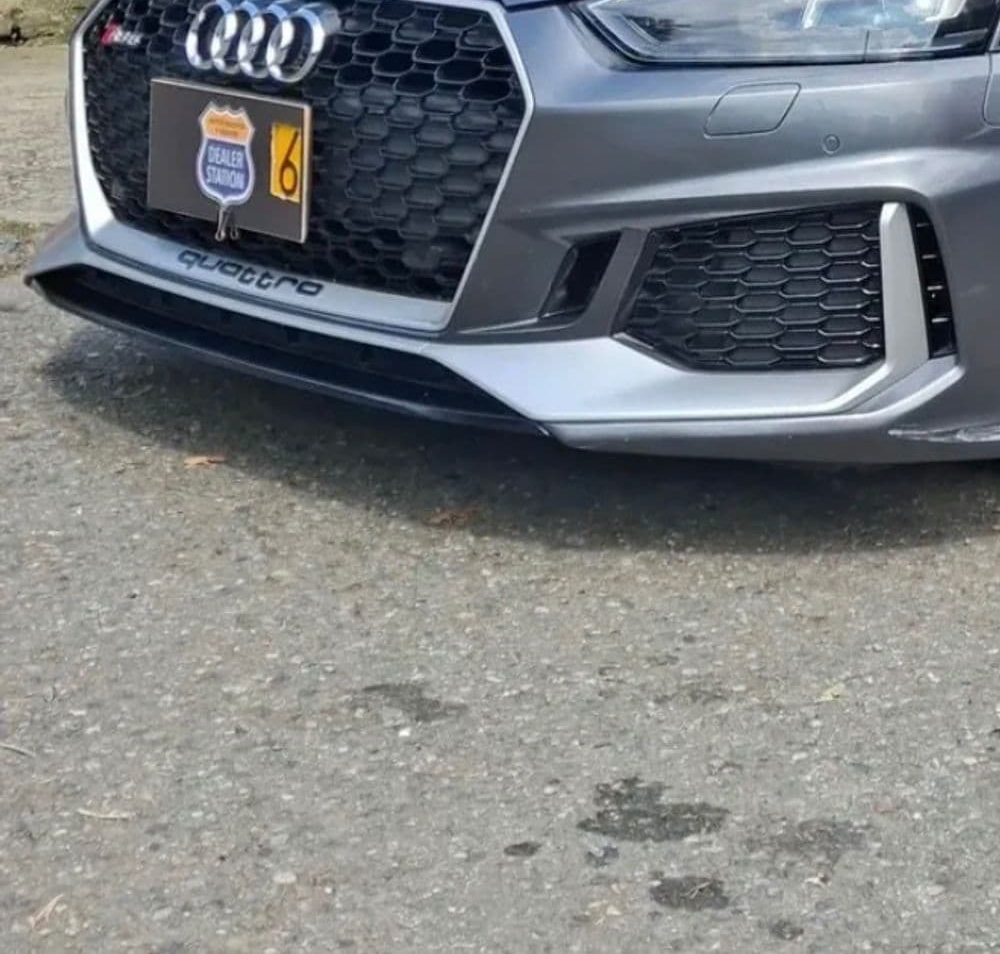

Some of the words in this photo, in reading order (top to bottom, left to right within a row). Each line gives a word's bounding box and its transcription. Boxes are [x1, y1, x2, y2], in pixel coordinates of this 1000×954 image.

[207, 145, 245, 169] DEALER
[279, 129, 299, 197] 6
[206, 165, 246, 190] STATION
[177, 249, 325, 297] quattro
